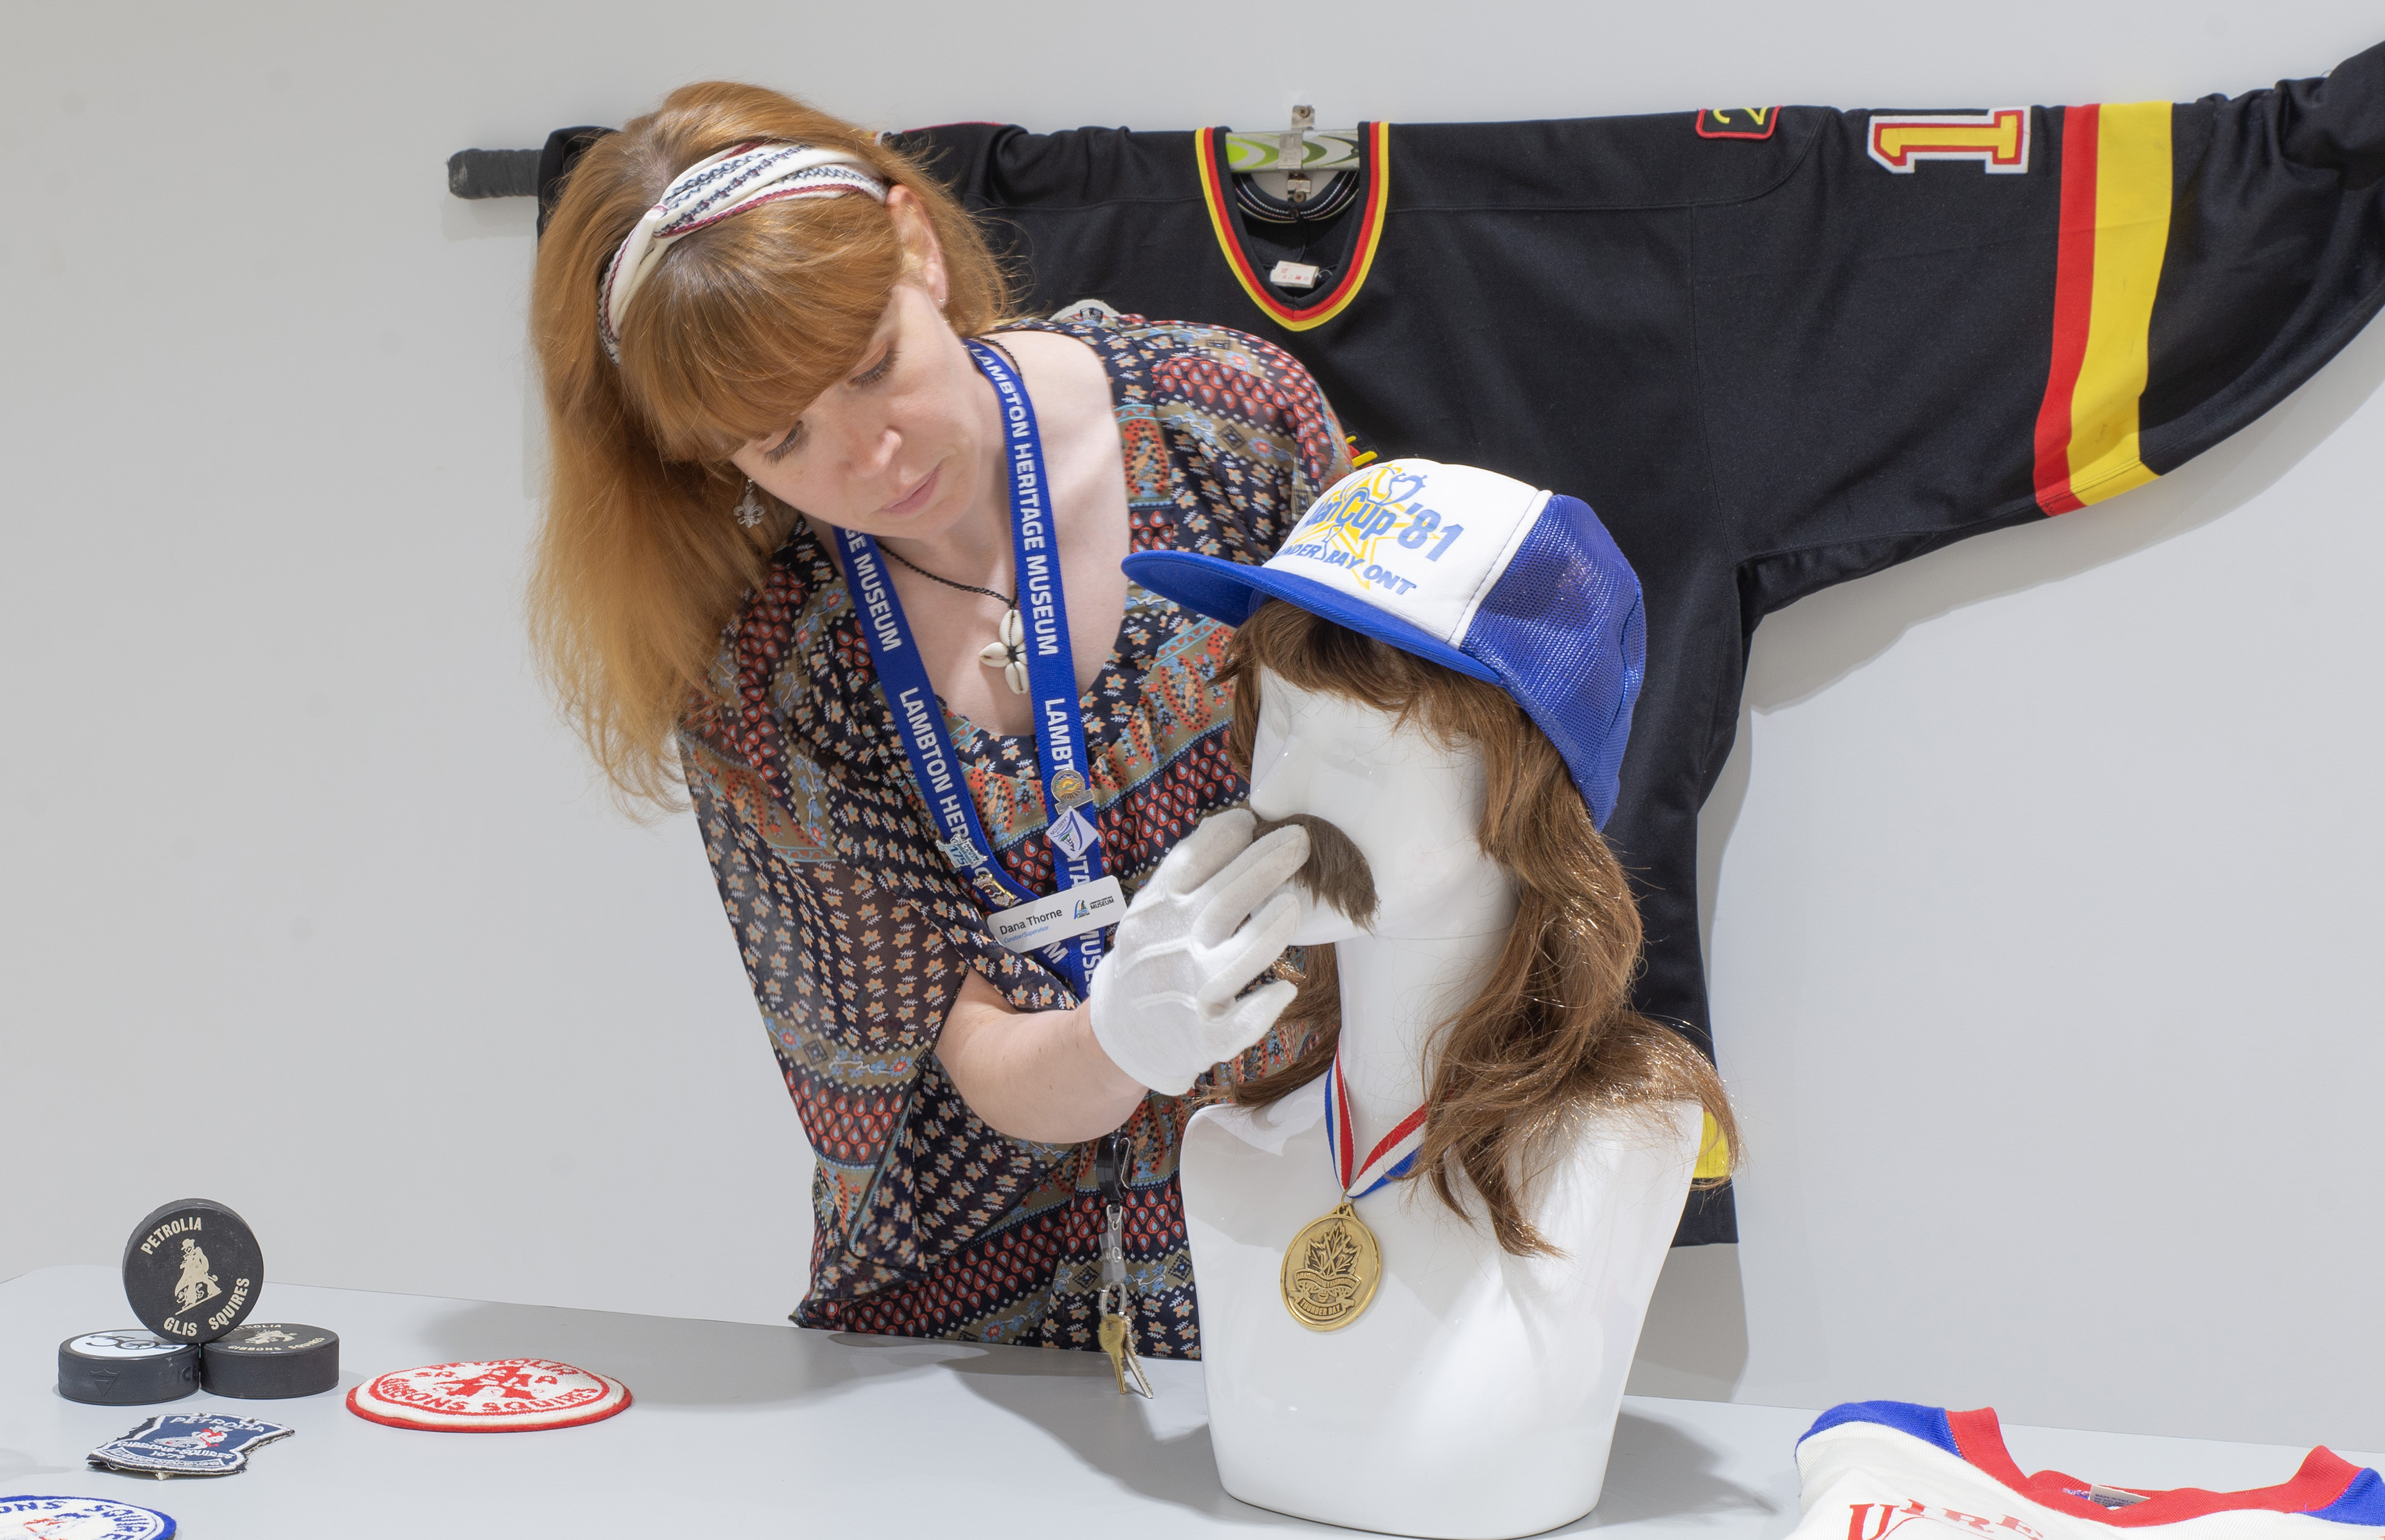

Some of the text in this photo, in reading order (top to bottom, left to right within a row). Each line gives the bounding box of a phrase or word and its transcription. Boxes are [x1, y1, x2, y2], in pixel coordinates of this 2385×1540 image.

[970, 347, 1060, 656] LAMBTON HERITAGE MUSEUM
[1334, 489, 1397, 541] Cup
[1397, 503, 1465, 562] '81
[1324, 550, 1365, 570] BAY
[1363, 564, 1417, 596] ONT
[853, 553, 903, 652] MUSEUM
[899, 687, 953, 792] LAMBTON
[1044, 697, 1075, 771] LAMBT
[949, 845, 966, 867] 175
[999, 921, 1027, 935] Dana
[1026, 909, 1063, 926] Thorne
[1090, 898, 1115, 910] MUSEUM
[1004, 925, 1049, 944] Curator/Supervisor
[140, 1216, 202, 1256] PETROLIA
[164, 1278, 250, 1337] GLIS SQUIRES
[1300, 1298, 1341, 1316] THUNDER BAY
[288, 1337, 325, 1349] SQUIRES
[169, 1416, 265, 1433] PETROLIA
